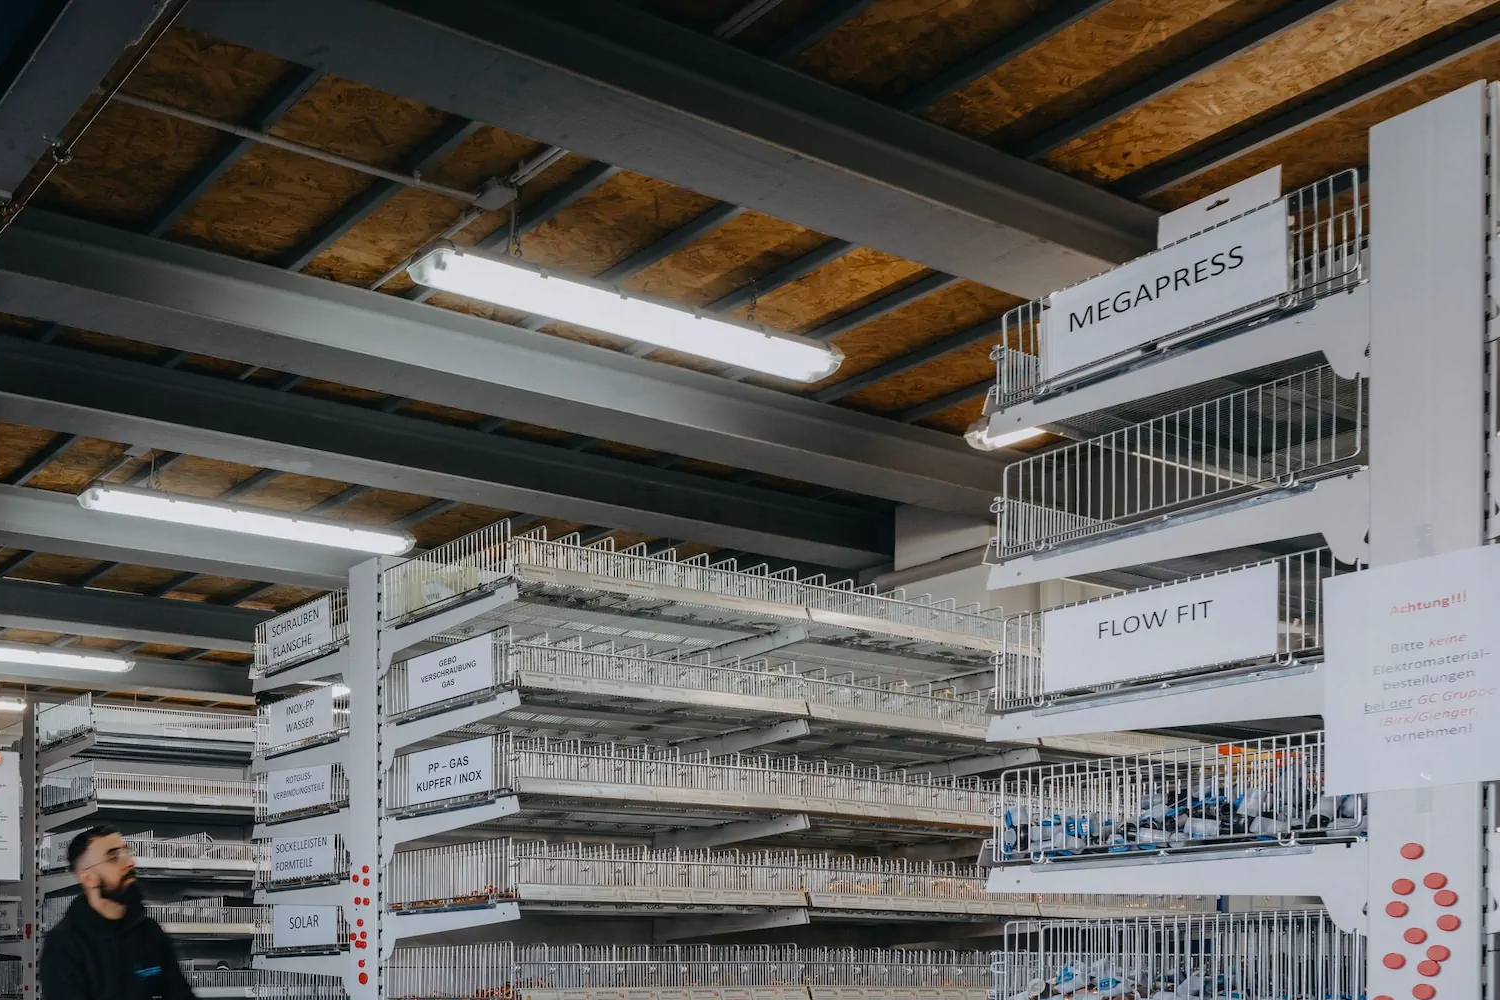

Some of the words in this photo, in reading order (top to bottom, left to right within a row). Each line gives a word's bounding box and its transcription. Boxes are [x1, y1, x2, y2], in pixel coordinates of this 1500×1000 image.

[1069, 245, 1244, 333] MEGAPRESS
[1389, 590, 1467, 615] Achtung!!!
[271, 606, 320, 638] SCHRAUBEN
[1098, 608, 1168, 640] FLOW
[1177, 600, 1213, 623] FIT
[272, 633, 312, 659] FLANSCHE
[1391, 640, 1424, 654] Bitte
[1428, 633, 1468, 648] keine
[420, 660, 477, 684] VERSCHRAUBUNG
[438, 655, 457, 668] GEBO
[1373, 648, 1491, 676] Elektromaterial-
[441, 678, 455, 689] GAS
[1383, 668, 1475, 691] bestellungen
[285, 699, 315, 717] INOX-PP
[1364, 700, 1387, 714] bei
[1390, 697, 1414, 710] der
[1417, 692, 1439, 706] GC
[1442, 686, 1498, 702] Gruppe
[285, 716, 315, 733] WASSER
[1385, 723, 1473, 744] vornehmen!
[428, 762, 440, 774] PP
[449, 755, 469, 769] GAS
[285, 770, 313, 785] ROTGUSS-
[416, 776, 452, 793] KUPFER
[459, 769, 482, 784] INOX
[273, 781, 325, 800] VERBINDUNGSTEILE
[275, 836, 328, 854] SOCKELLEISTEN
[275, 857, 313, 872] FORMTEILE
[289, 914, 319, 930] SOLAR
